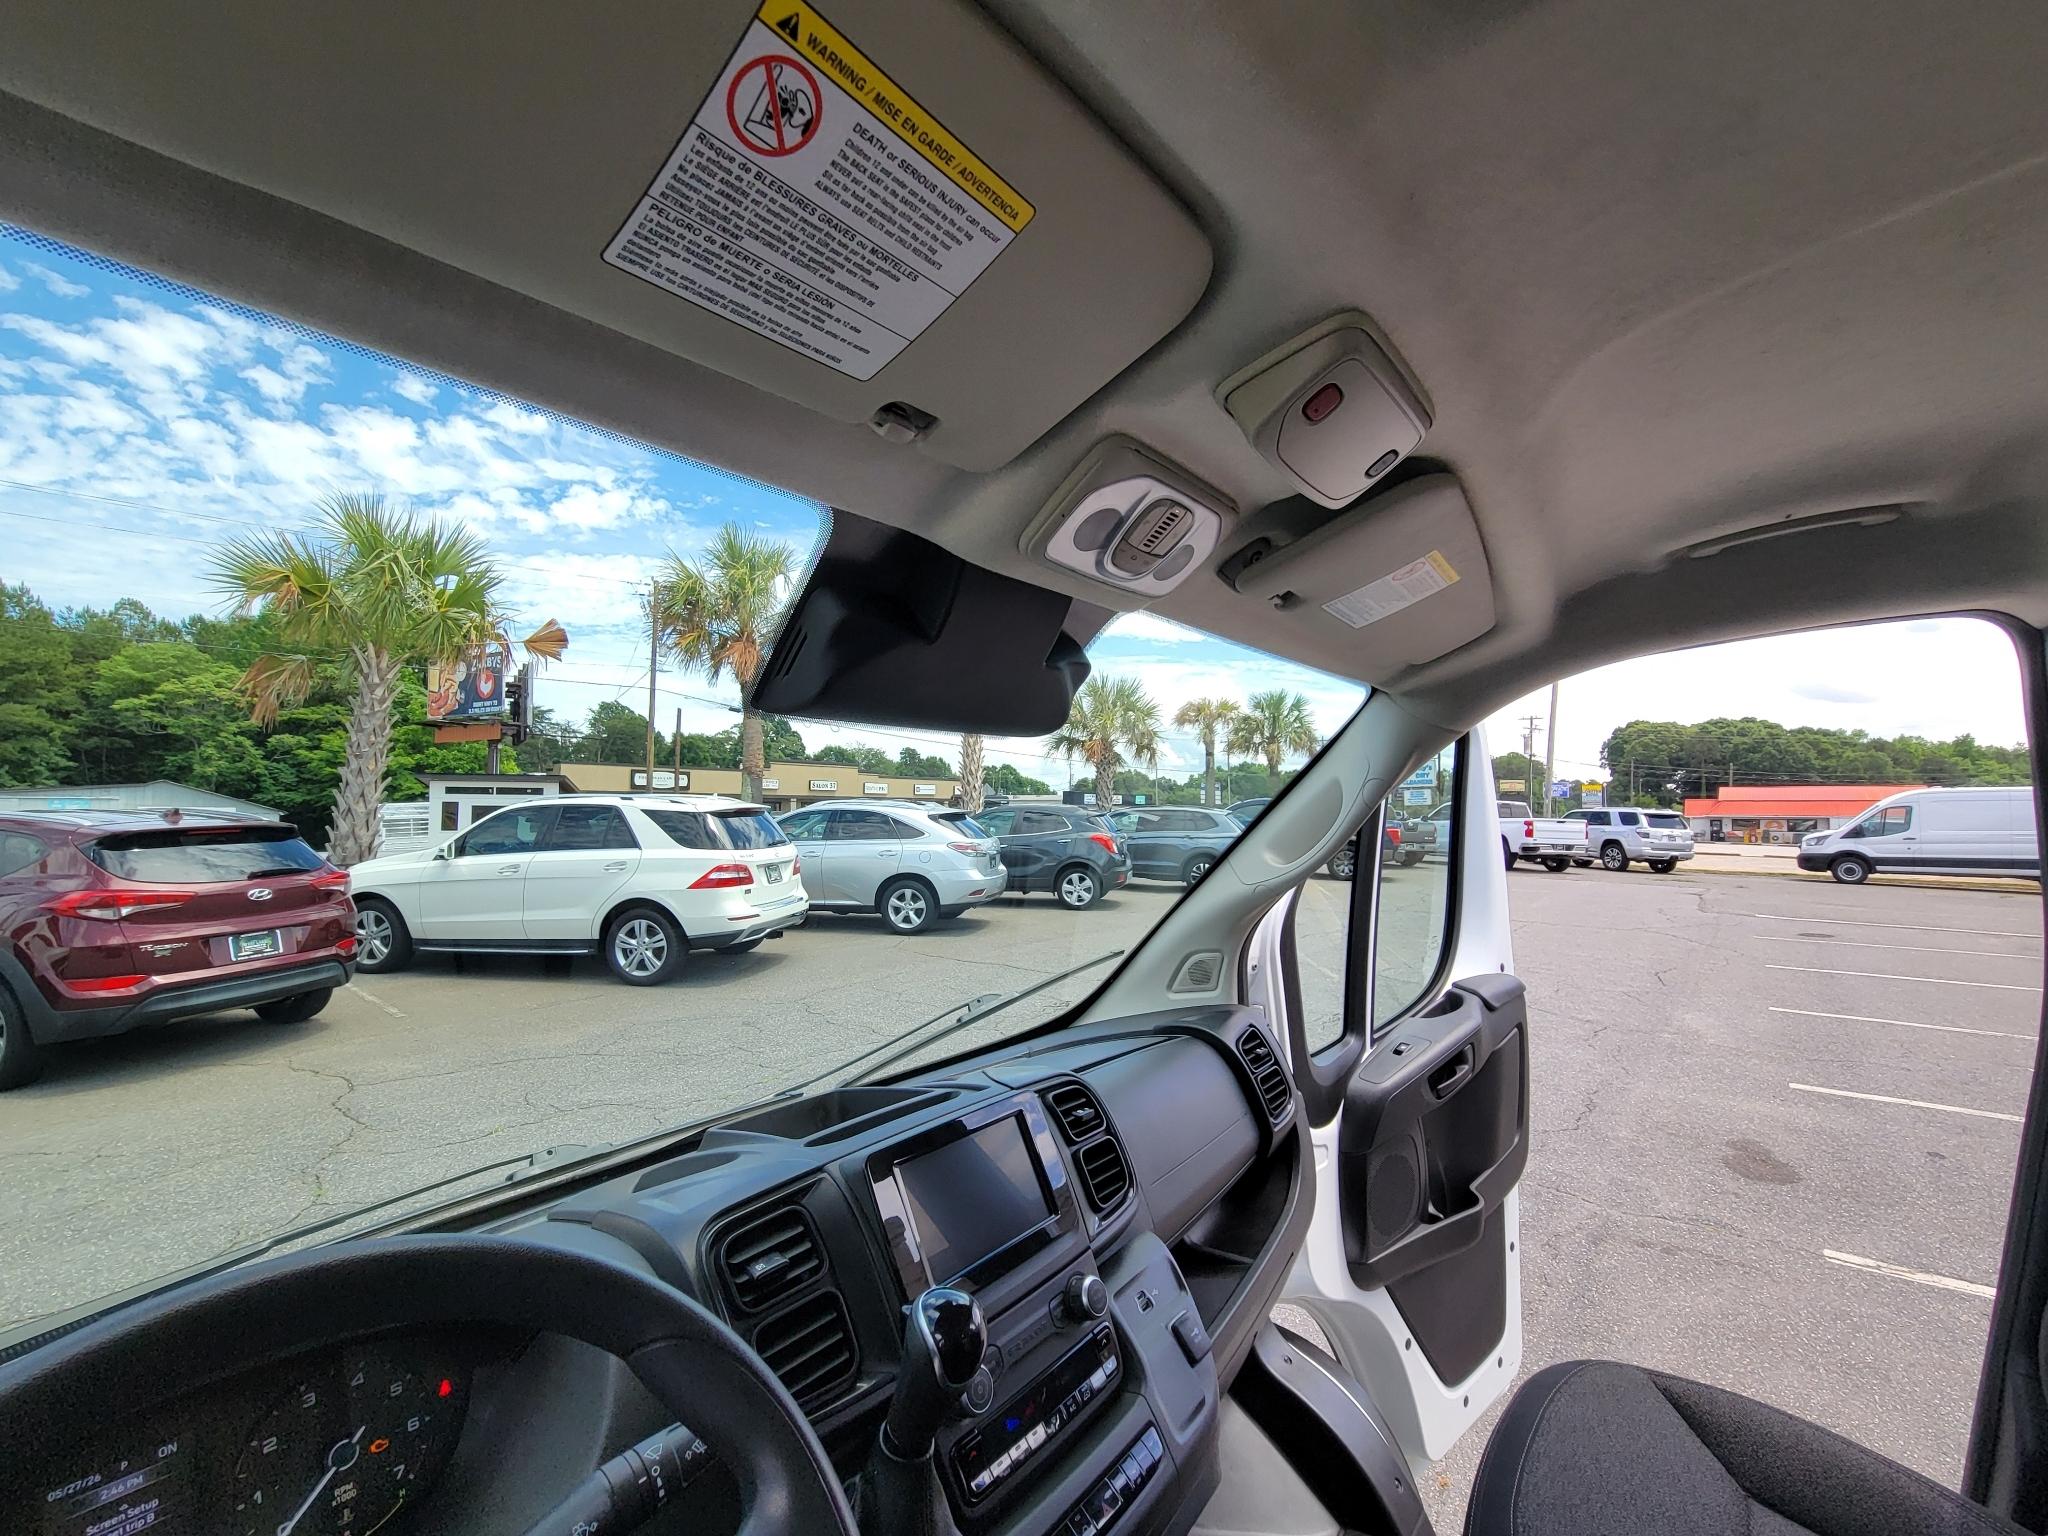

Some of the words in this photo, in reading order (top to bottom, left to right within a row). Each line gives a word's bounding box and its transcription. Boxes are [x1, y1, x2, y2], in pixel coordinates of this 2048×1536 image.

[806, 32, 867, 92] WARNING
[872, 91, 903, 122] MISE
[900, 116, 919, 136] EN
[917, 130, 956, 167] GARDE
[956, 166, 1019, 221] ADVERTENCIA
[852, 122, 888, 154] DEATH
[886, 151, 898, 162] or
[897, 158, 938, 194] SERIOUS
[936, 189, 968, 216] INJURY
[965, 214, 980, 228] can
[979, 225, 1001, 243] occur
[695, 131, 737, 165] Risque
[737, 161, 752, 175] de
[752, 169, 818, 216] BLESSURES
[817, 212, 857, 242] GRAVES
[855, 239, 869, 251] ou
[868, 246, 919, 282] MORTELLES
[648, 202, 703, 237] PELIGRO
[702, 234, 718, 246] de
[718, 241, 764, 271] MUERTE
[771, 271, 801, 292] SERIA
[351, 1372, 364, 1387] 4
[390, 1381, 403, 1397] 5
[302, 1392, 316, 1408] 3
[407, 1417, 420, 1432] 6
[158, 1441, 178, 1458] ON
[262, 1436, 278, 1455] 2
[393, 1464, 406, 1480] 7
[126, 1475, 144, 1489] PM
[334, 1482, 354, 1497] RPM
[253, 1490, 263, 1504] 1
[86, 1512, 126, 1536] Screen
[126, 1498, 159, 1518] Setup
